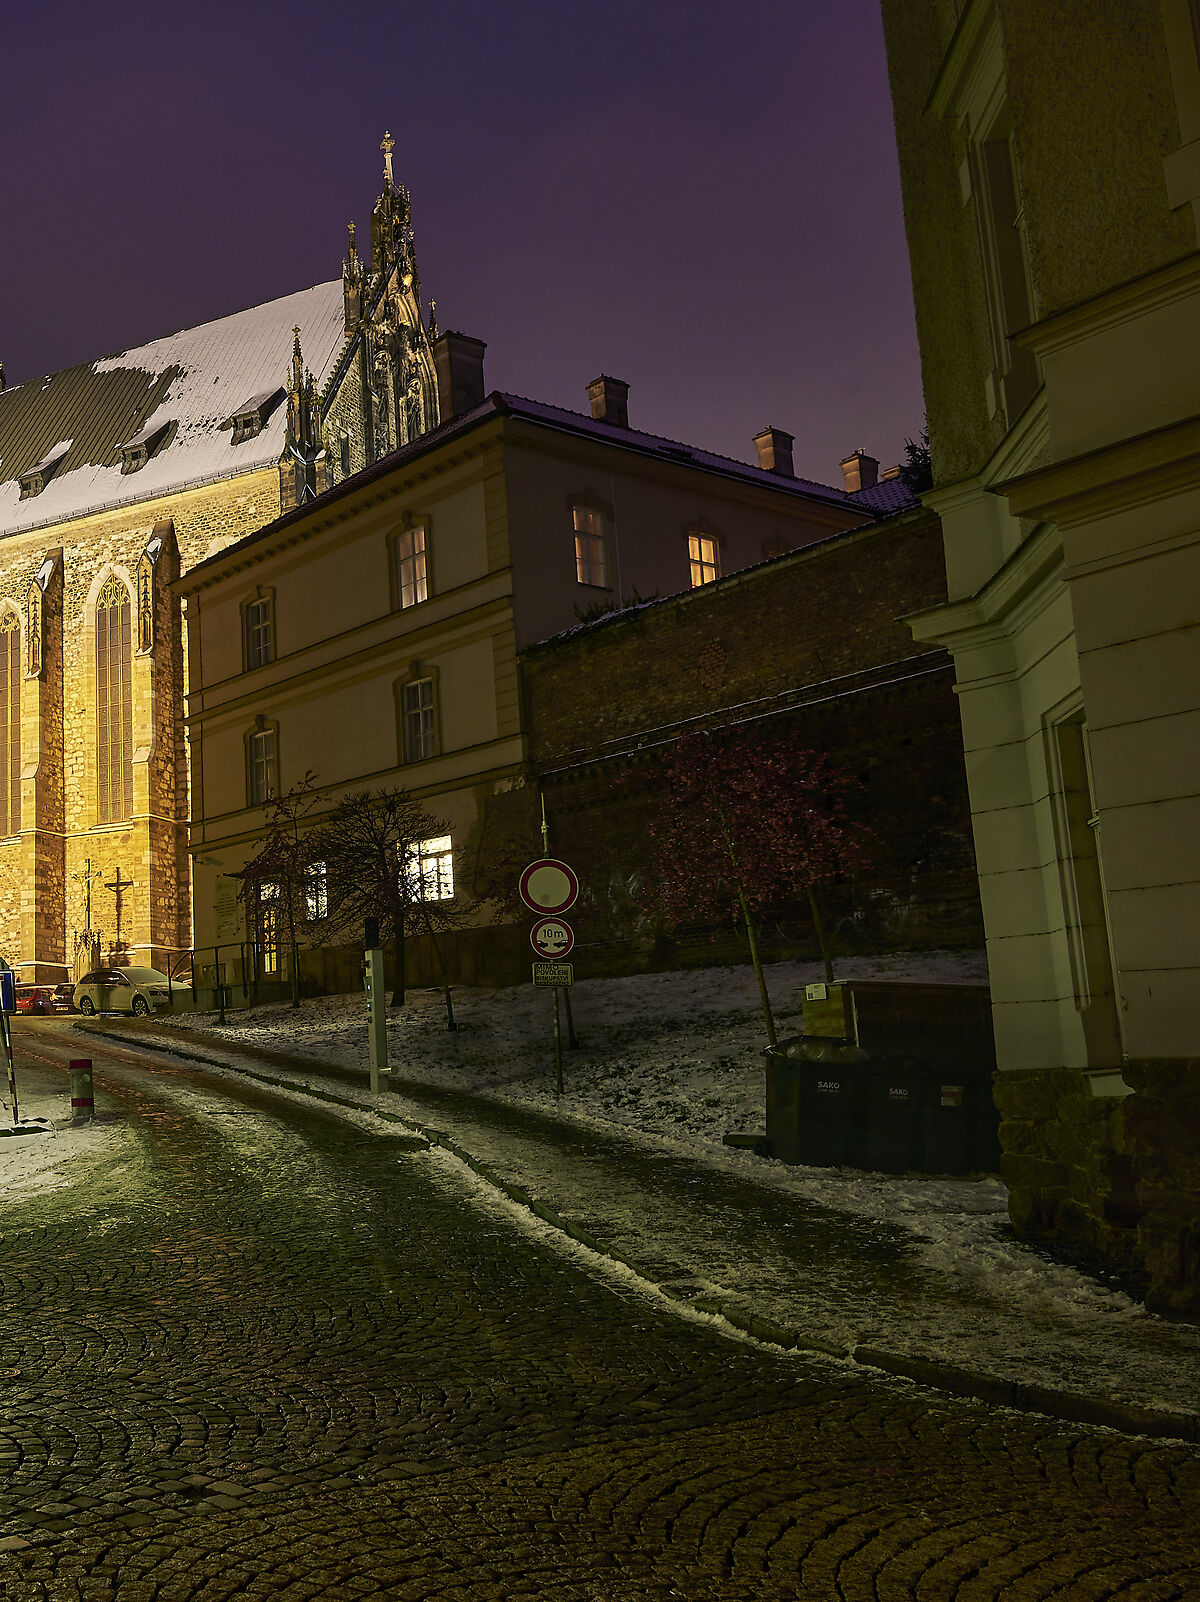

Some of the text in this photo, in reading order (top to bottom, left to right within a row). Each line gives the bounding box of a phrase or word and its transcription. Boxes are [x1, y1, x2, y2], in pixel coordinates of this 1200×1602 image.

[543, 929, 553, 938] 10
[818, 1081, 840, 1089] SAKO
[889, 1088, 908, 1096] SAKO
